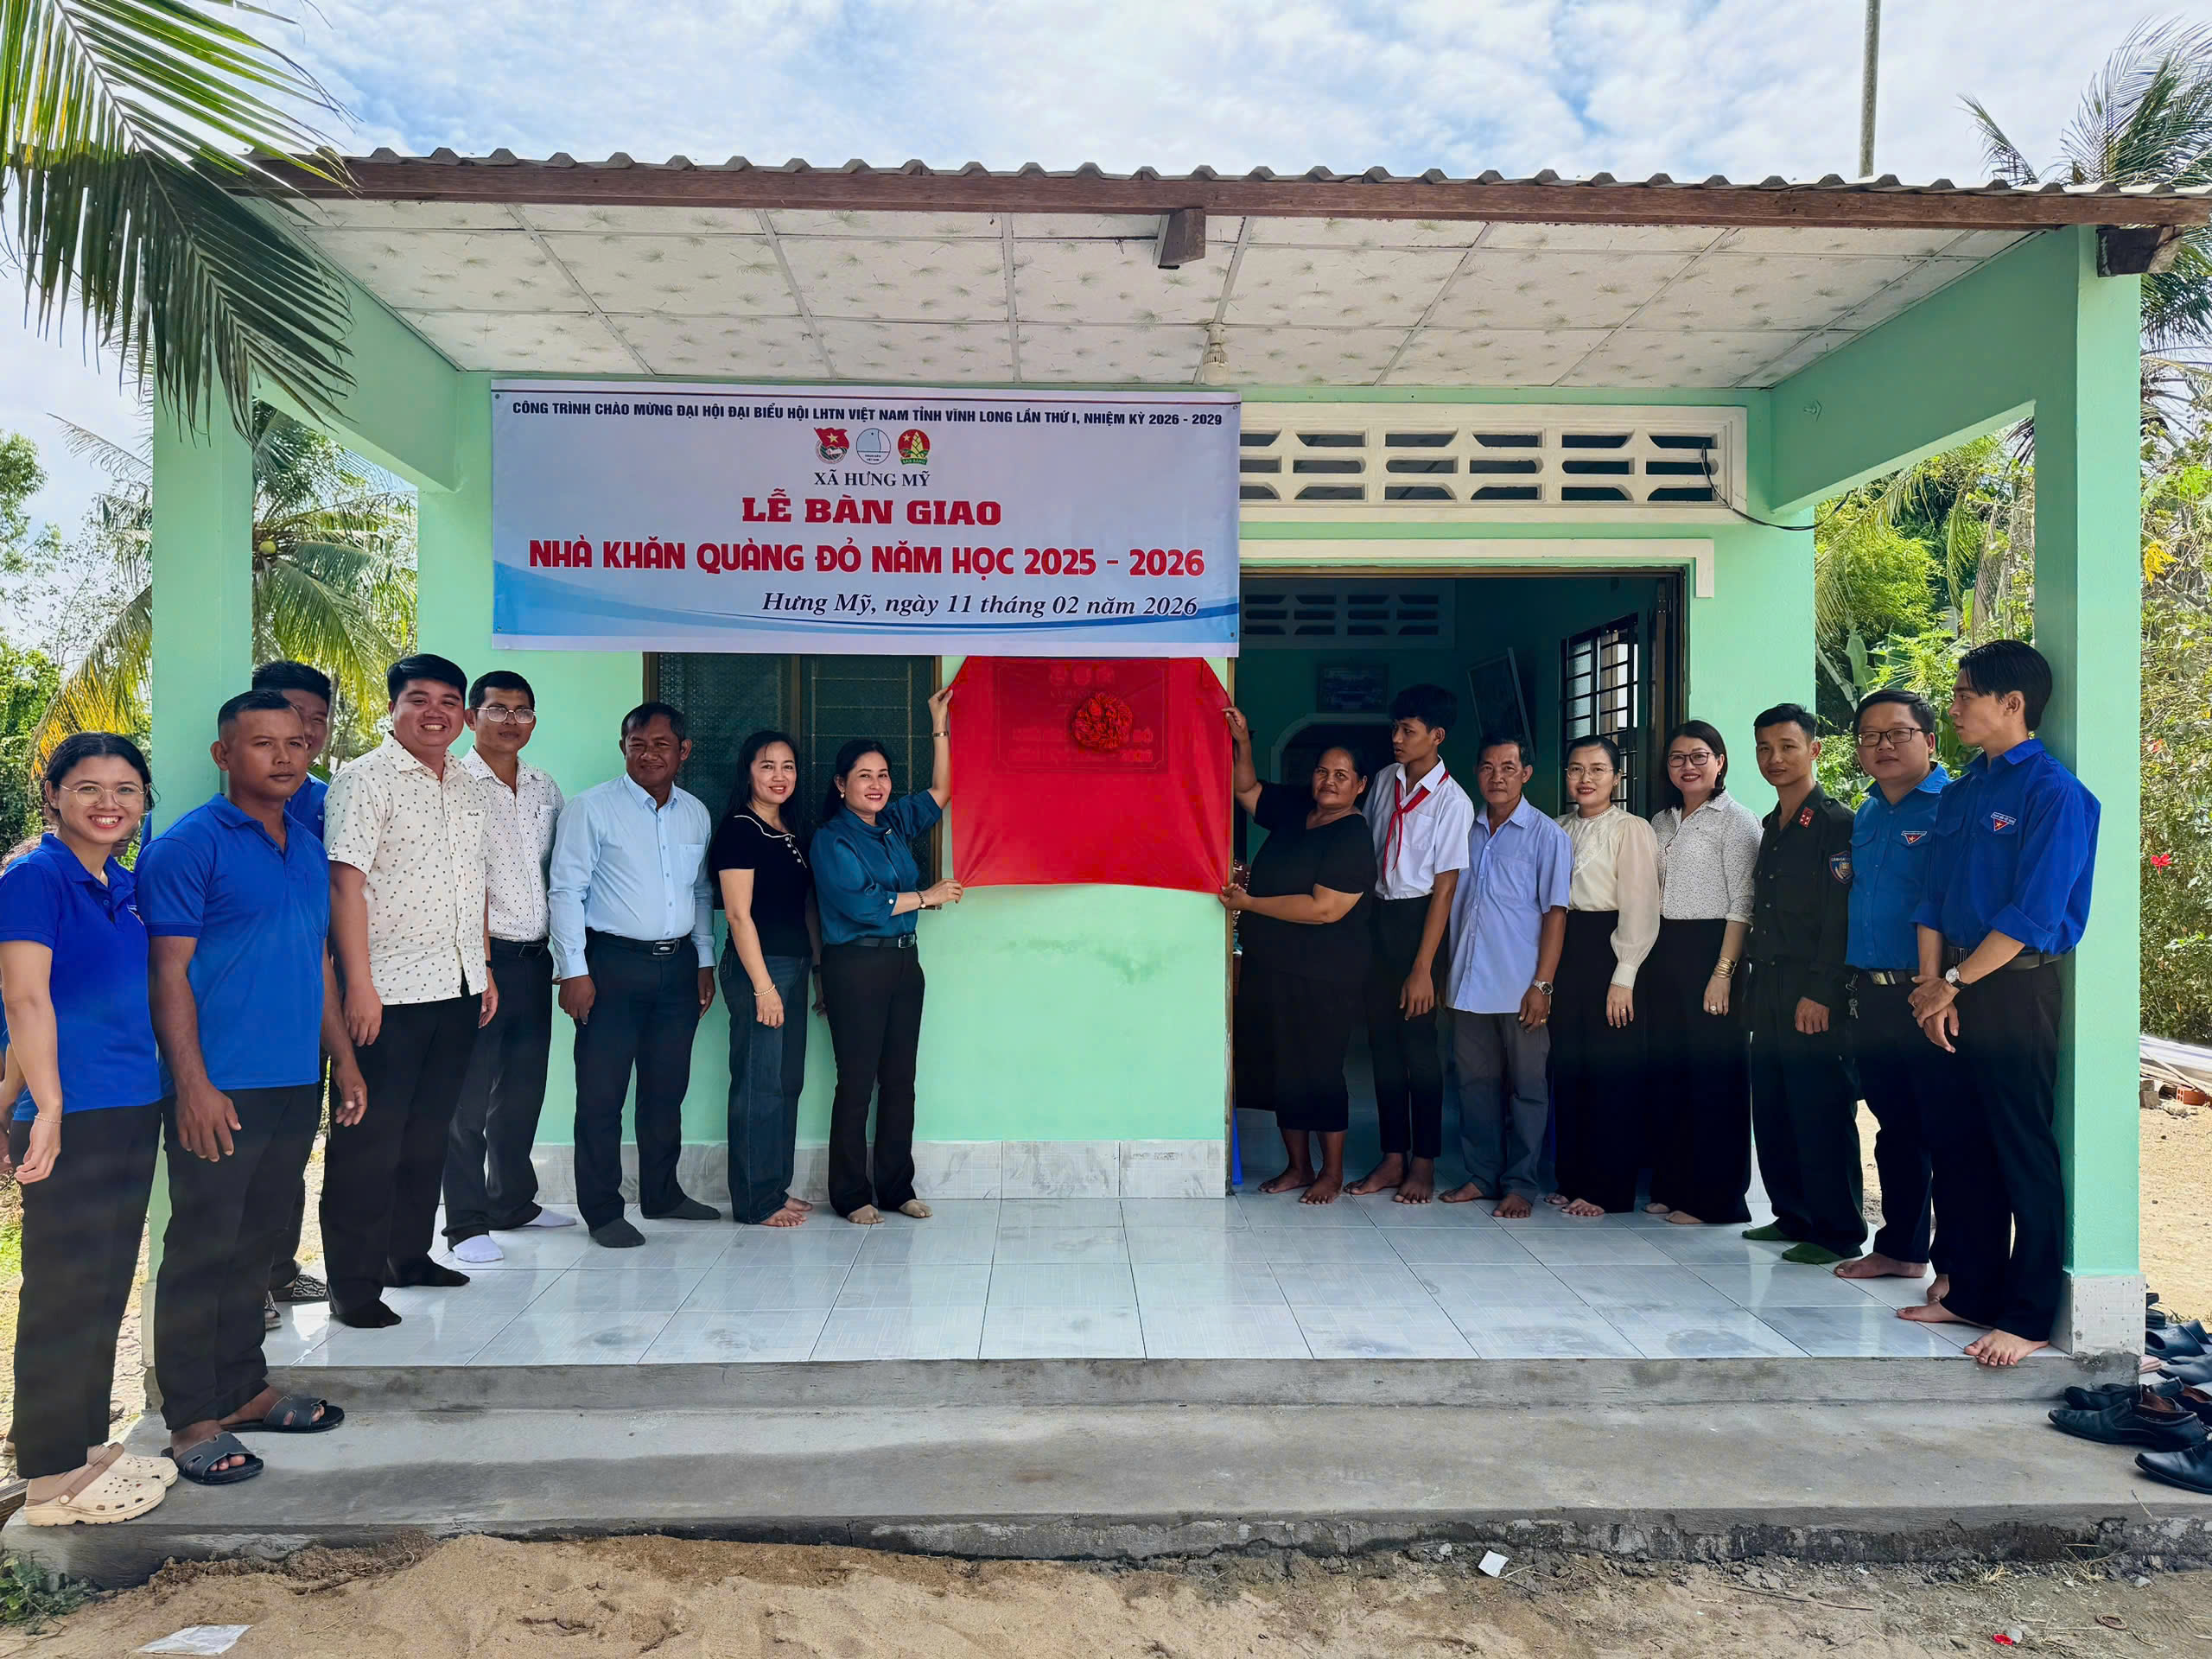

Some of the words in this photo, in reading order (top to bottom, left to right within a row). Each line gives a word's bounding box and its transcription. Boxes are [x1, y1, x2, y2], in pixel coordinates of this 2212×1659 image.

[512, 399, 549, 415] CÔNG
[551, 400, 591, 416] TRÌNH
[594, 401, 630, 416] CHÀO
[633, 401, 673, 416] MỪNG
[676, 404, 699, 419] ĐẠI
[702, 403, 725, 420] HỘI
[728, 405, 750, 421] ĐẠI
[753, 402, 784, 419] BIỂU
[787, 404, 810, 422] HỘI
[812, 407, 845, 420] LHTN
[848, 406, 876, 423] VIỆT
[878, 409, 909, 422] NAM
[912, 405, 942, 422] TỈNH
[944, 408, 976, 423] VĨNH
[979, 410, 1014, 423] LONG
[1016, 407, 1041, 423] LẦN
[1044, 410, 1071, 424] THỨ
[1071, 411, 1080, 426] I,
[1084, 410, 1126, 427] NHIỆM
[1128, 410, 1146, 425] KỲ
[1148, 413, 1179, 425] 2026
[1191, 413, 1223, 426] 2029
[813, 468, 840, 486] XÃ
[844, 470, 897, 487] HƯNG
[901, 470, 931, 487] MỸ
[741, 487, 792, 523] LỄ
[804, 493, 894, 524] BÀN
[906, 499, 1001, 526] GIAO
[529, 534, 593, 569] NHÀ
[602, 536, 686, 570] KHĂN
[696, 537, 804, 575] QUÀNG
[814, 537, 862, 573] ĐỎ
[871, 540, 943, 574] NĂM
[951, 546, 1014, 582] HỌC
[1024, 547, 1096, 576] 2025
[1128, 548, 1205, 577] 2026
[761, 592, 829, 616] Hưng
[833, 593, 876, 616] Mỹ,
[885, 594, 939, 617] ngày
[946, 594, 972, 613] 11
[980, 594, 1046, 619] tháng
[1052, 595, 1079, 615] 02
[1085, 596, 1135, 615] năm
[1141, 596, 1198, 616] 2026
